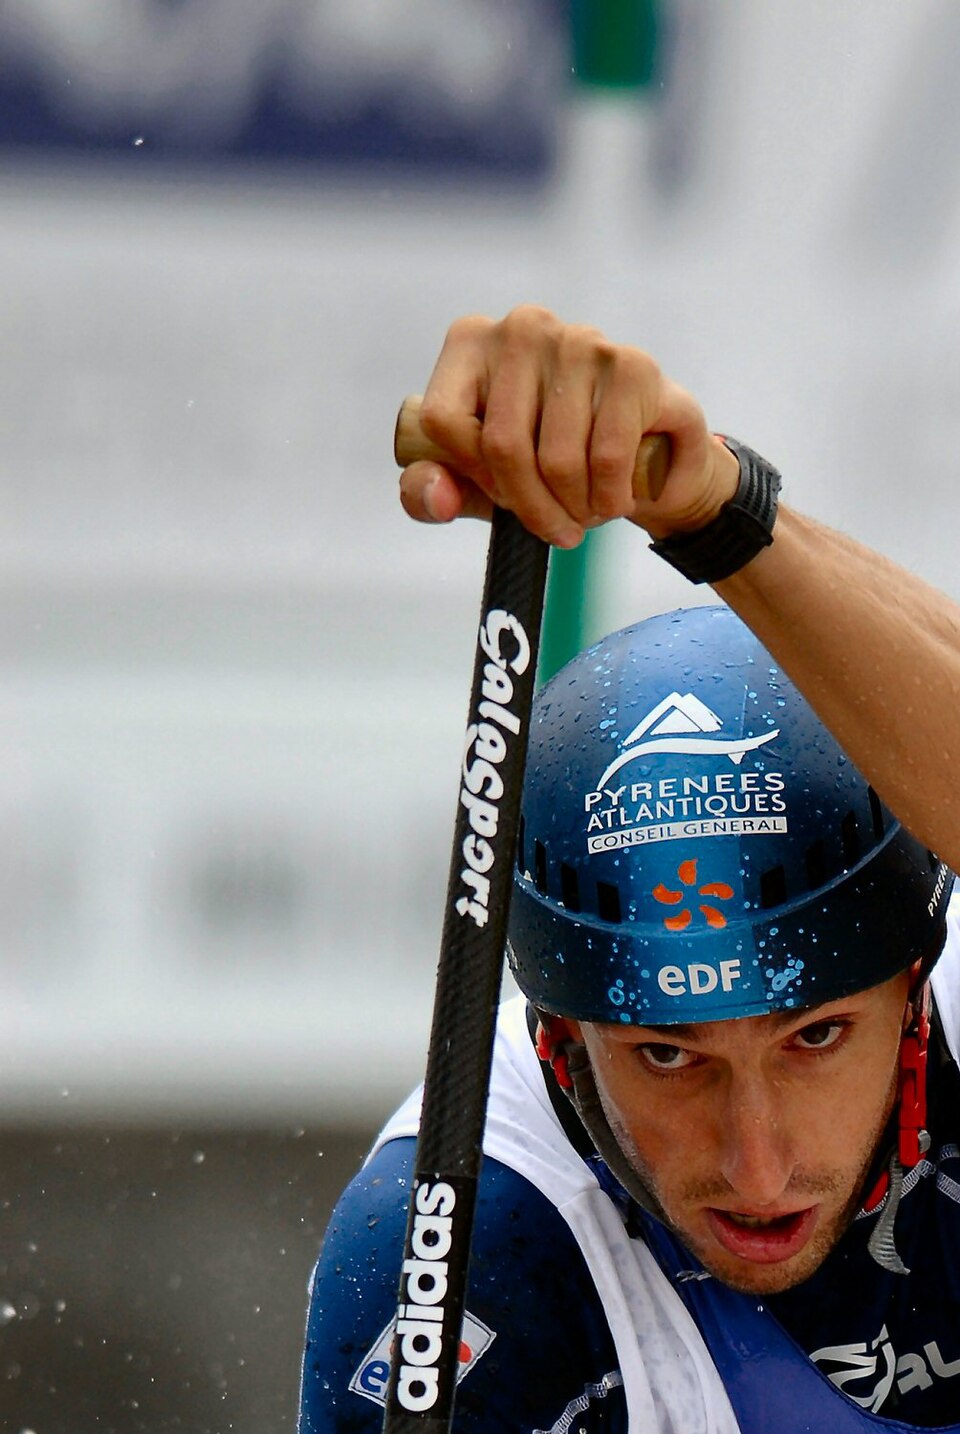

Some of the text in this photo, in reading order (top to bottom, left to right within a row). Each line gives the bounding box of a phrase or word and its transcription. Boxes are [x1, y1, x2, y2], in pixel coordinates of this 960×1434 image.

[584, 772, 785, 812] PYRENEES
[586, 793, 787, 832] ATLANTIQUES
[591, 819, 783, 850] CONSEIL GENERAL
[927, 863, 949, 917] PYREN
[657, 958, 741, 997] eDF
[397, 1181, 456, 1412] adidas
